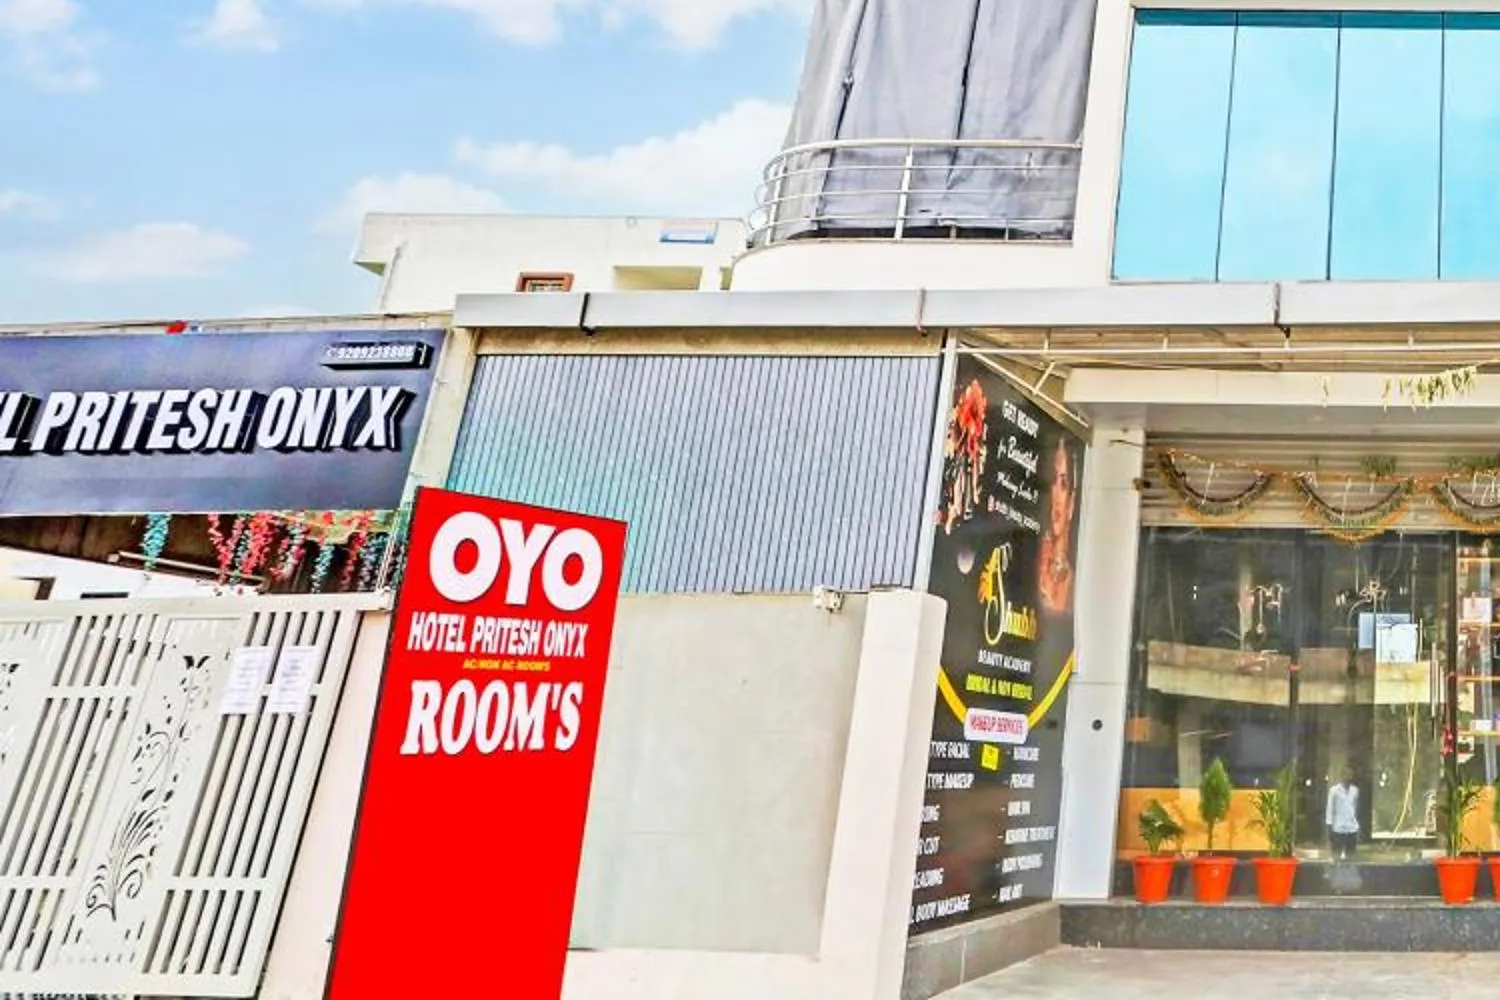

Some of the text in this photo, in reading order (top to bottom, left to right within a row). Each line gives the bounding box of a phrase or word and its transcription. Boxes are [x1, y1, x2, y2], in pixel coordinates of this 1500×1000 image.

[30, 388, 254, 452] PRITESH
[257, 385, 404, 450] ONYX
[429, 510, 603, 611] OYO
[407, 611, 588, 658] HOTEL PRITESH ONYX
[400, 679, 584, 756] ROOM'S
